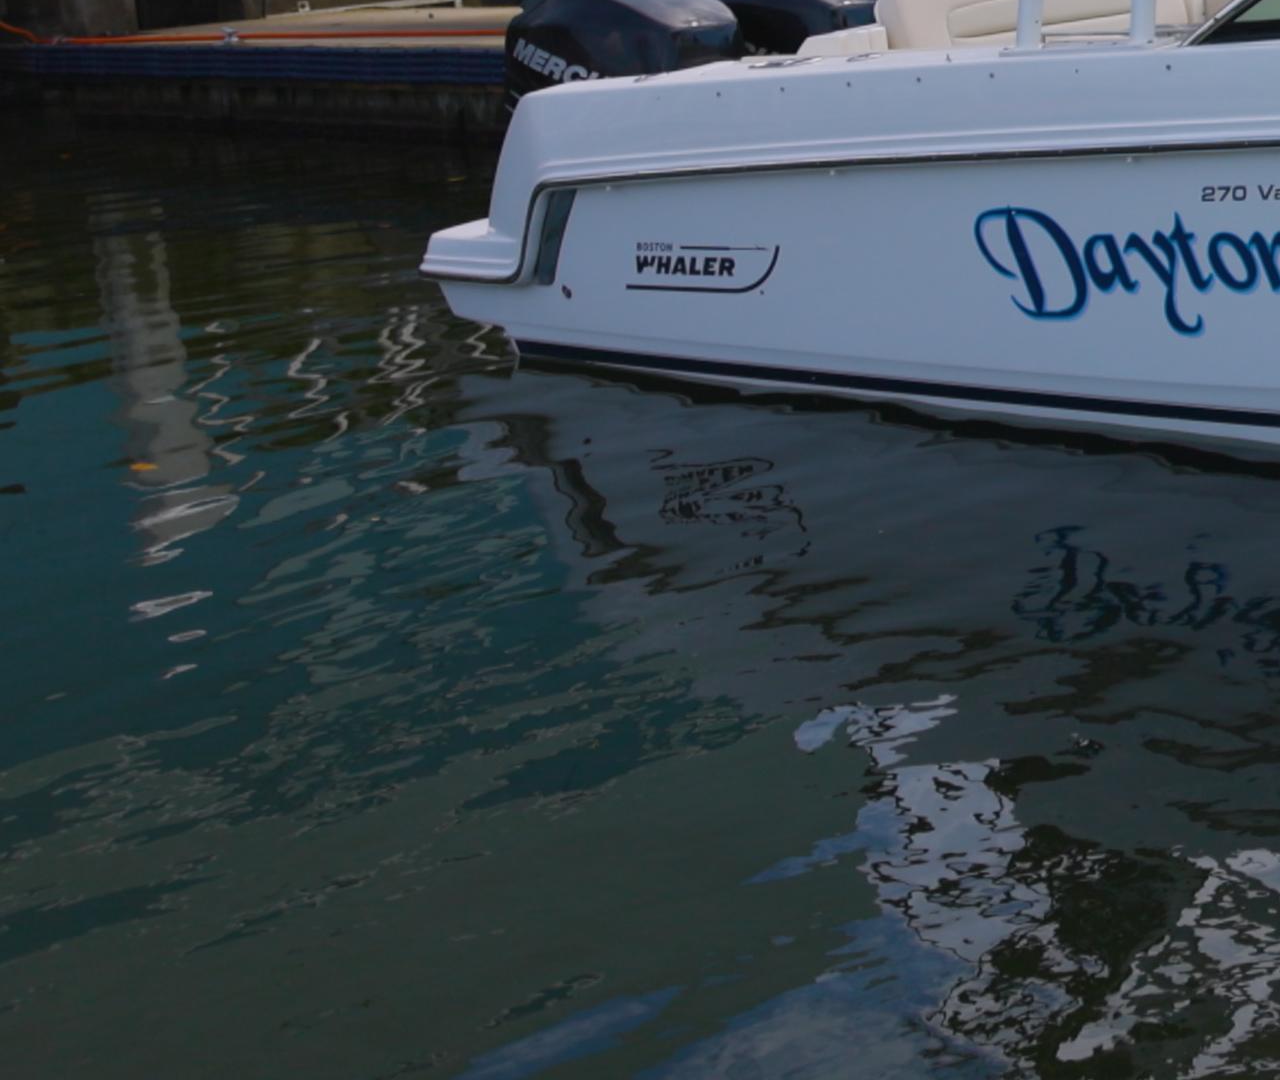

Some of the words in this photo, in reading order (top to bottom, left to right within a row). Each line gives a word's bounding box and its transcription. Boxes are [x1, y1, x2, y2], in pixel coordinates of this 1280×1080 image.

[513, 38, 600, 82] MERC
[1201, 185, 1247, 202] 270
[636, 242, 673, 252] BOSTON
[636, 255, 736, 277] WHALER
